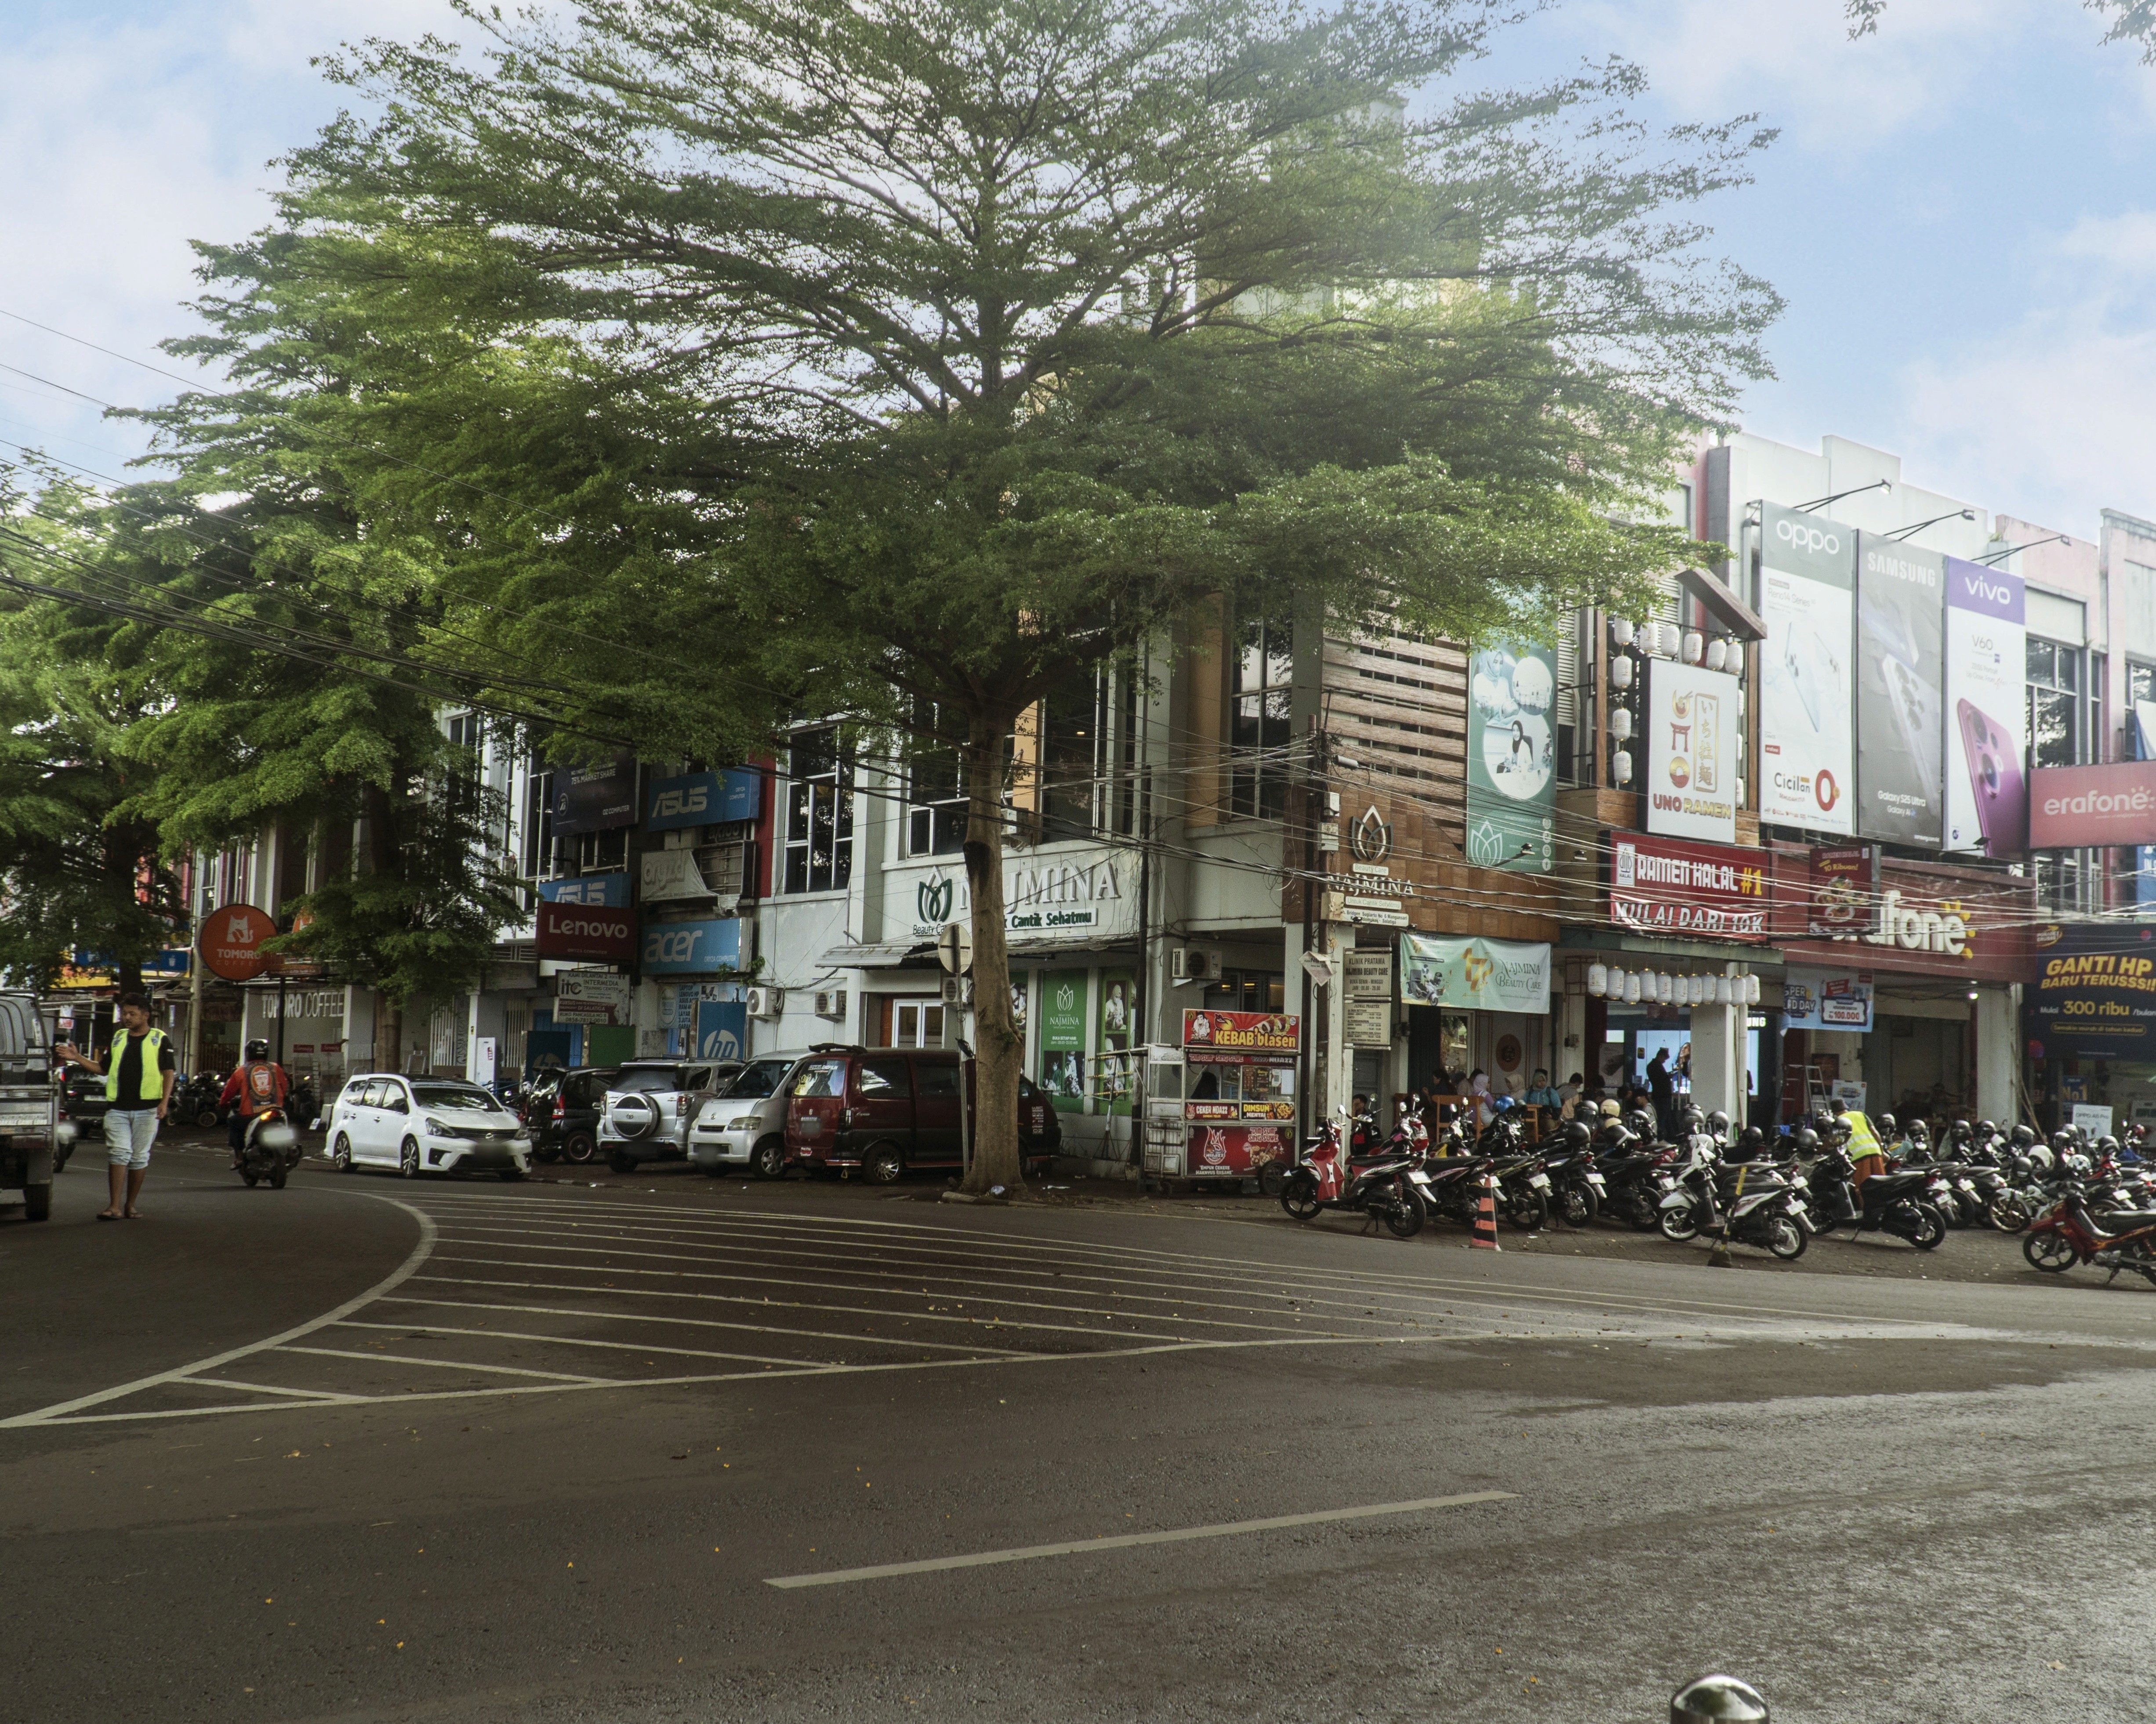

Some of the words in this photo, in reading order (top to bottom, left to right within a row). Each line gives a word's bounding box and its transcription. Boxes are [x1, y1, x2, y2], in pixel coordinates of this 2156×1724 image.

[1776, 519, 1840, 554] oppo
[1867, 551, 1936, 587] SAMSUNG
[1965, 575, 2011, 605] vivo
[1791, 594, 1811, 607] Series
[1971, 634, 1993, 651] V60
[600, 768, 616, 779] SHARE
[1774, 772, 1811, 793] Cicilan
[652, 786, 708, 818] ASUS
[1653, 793, 1682, 812] UNO
[1683, 797, 1731, 820] RAMEN
[1877, 790, 1900, 804] Galaxy
[1900, 794, 1911, 804] S25
[1912, 796, 1926, 807] Ultra
[2044, 790, 2149, 815] erafone
[609, 805, 630, 814] COMPUTER
[1887, 805, 1906, 817] Galaxy
[1355, 864, 1374, 873] Beauty
[1637, 854, 1690, 885] RAMEN
[1692, 862, 1739, 891] HALAL
[1741, 867, 1762, 896] #1
[1328, 872, 1414, 896] NAJMINA
[1379, 900, 1400, 908] Sehatmu
[1011, 913, 1042, 928] Cantik
[1046, 911, 1092, 927] Sehatmu
[1615, 902, 1674, 926] MULAI
[1678, 907, 1725, 931] DARI
[1731, 915, 1764, 932] 10K
[549, 914, 628, 938] Lenovo
[913, 924, 934, 935] Beauty
[644, 930, 703, 963] acer
[1346, 967, 1363, 976] NAJMINA
[1378, 967, 1388, 976] CARE
[1498, 958, 1541, 978] NAJMINA
[2046, 956, 2116, 976] GANTI
[2118, 956, 2153, 977] HP
[1495, 972, 1525, 988] BEAUTY
[1526, 977, 1542, 992] CARE
[2040, 975, 2080, 989] BARU
[306, 991, 344, 1018] COFFEE
[1799, 1000, 1816, 1010] DAY
[2063, 1000, 2096, 1015] 300
[2098, 1002, 2130, 1016] ribu
[1049, 1016, 1079, 1026] NAJMINA
[1834, 1011, 1860, 1020] 100.000
[708, 1030, 736, 1059] hp
[1196, 1105, 1212, 1115] CEKER
[1243, 1104, 1270, 1112] DIMSUM
